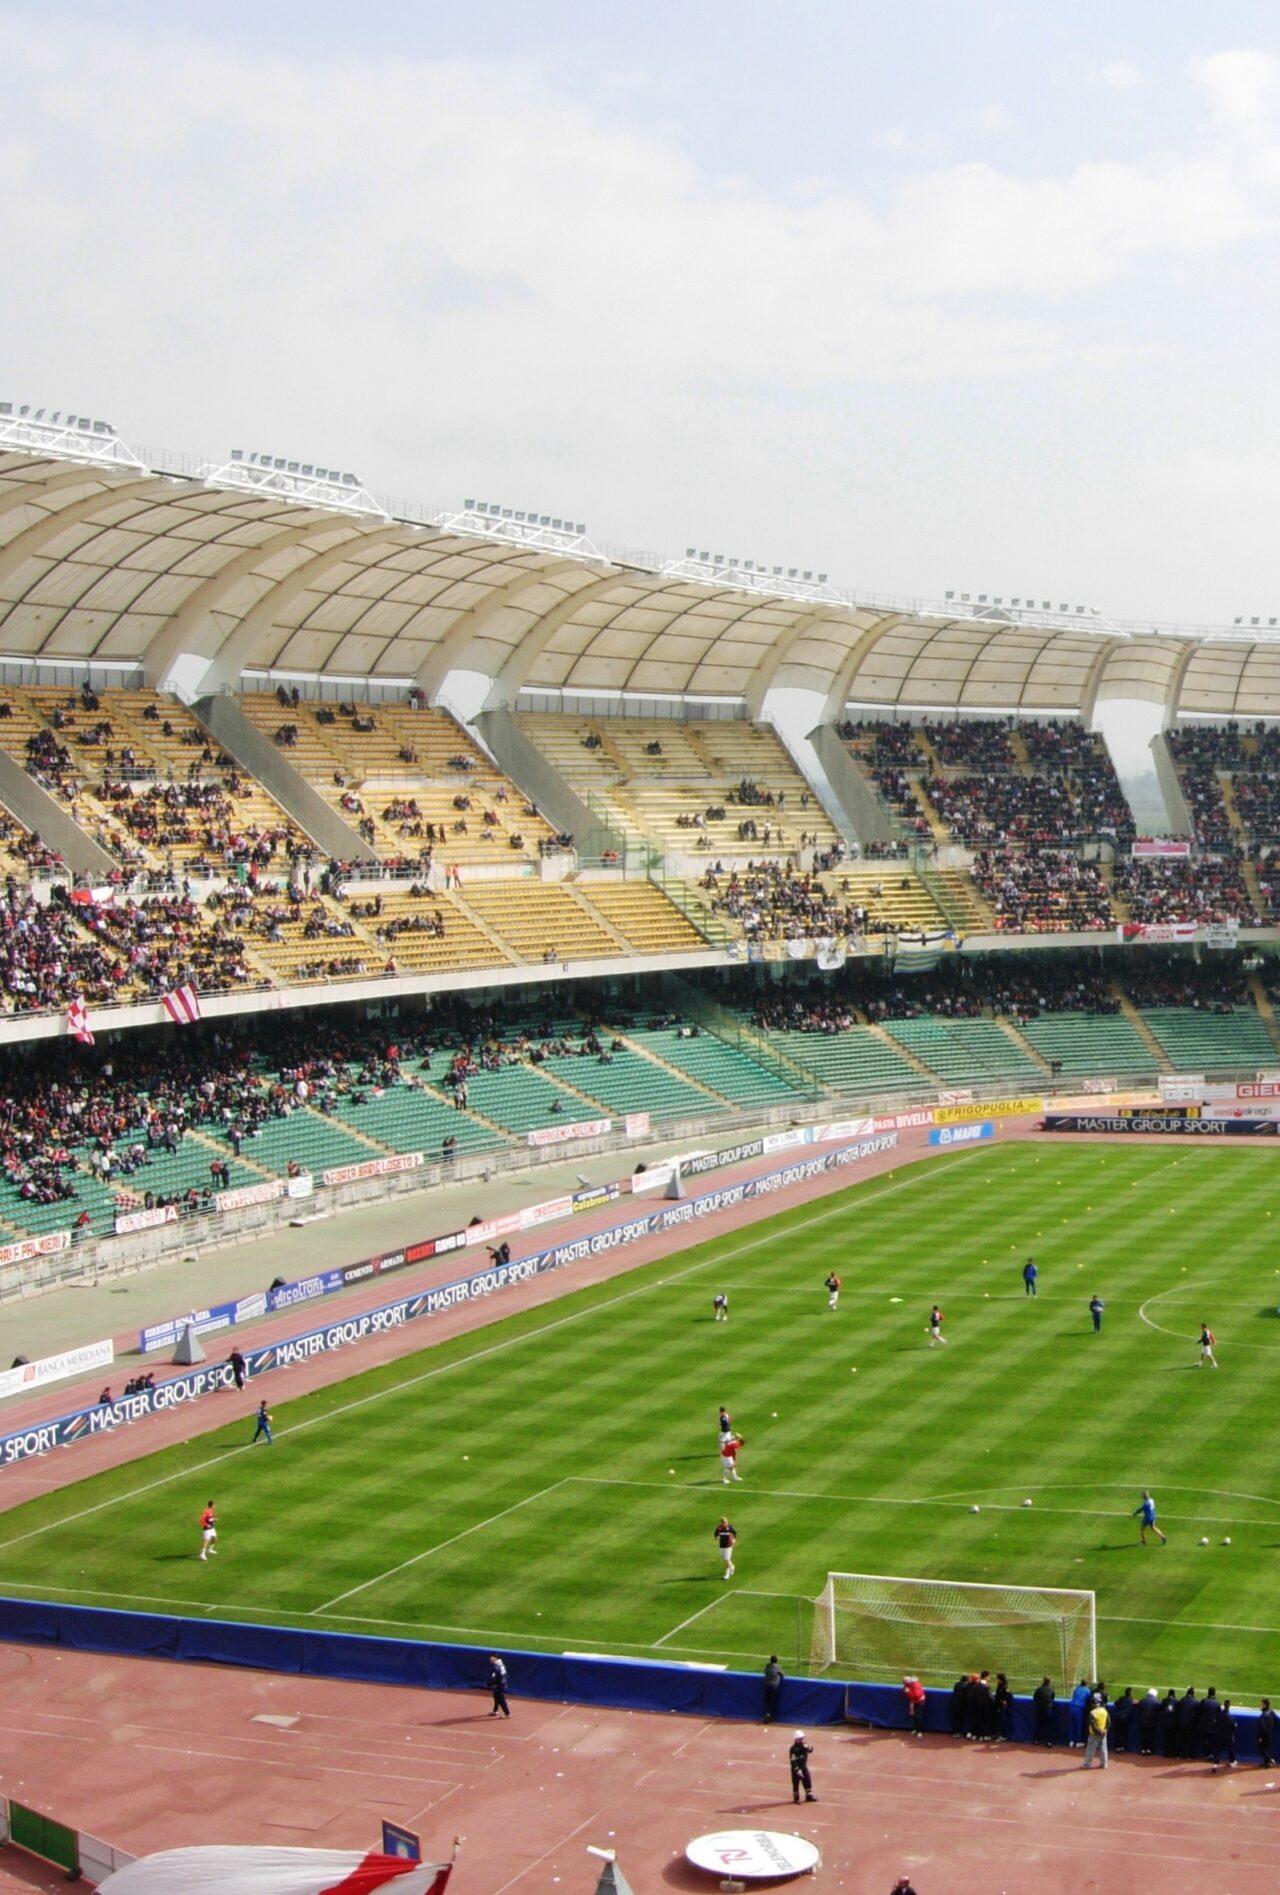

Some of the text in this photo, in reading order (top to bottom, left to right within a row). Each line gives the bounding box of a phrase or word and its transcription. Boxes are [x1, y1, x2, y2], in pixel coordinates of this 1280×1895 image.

[896, 1111, 934, 1128] DIVELLA
[947, 1100, 1024, 1116] FRIGOPUGLIA
[1077, 1118, 1228, 1132] MASTER GROUP SPORT
[691, 1140, 762, 1172] MASTER GROUP SPORT
[836, 1133, 898, 1164] MASTER GROUP SPORT
[756, 1158, 828, 1194] MASTER GROUP SPORT
[663, 1186, 745, 1226] MASTER GROUP SPORT
[555, 1219, 650, 1265] MASTER GROUP SPORT
[427, 1256, 540, 1311] MASTER GROUP SPORT
[276, 1303, 409, 1366] MASTER GROUP SPORT
[90, 1357, 252, 1432] MASTER GROUP SPOT
[6, 1424, 60, 1462] SPORT
